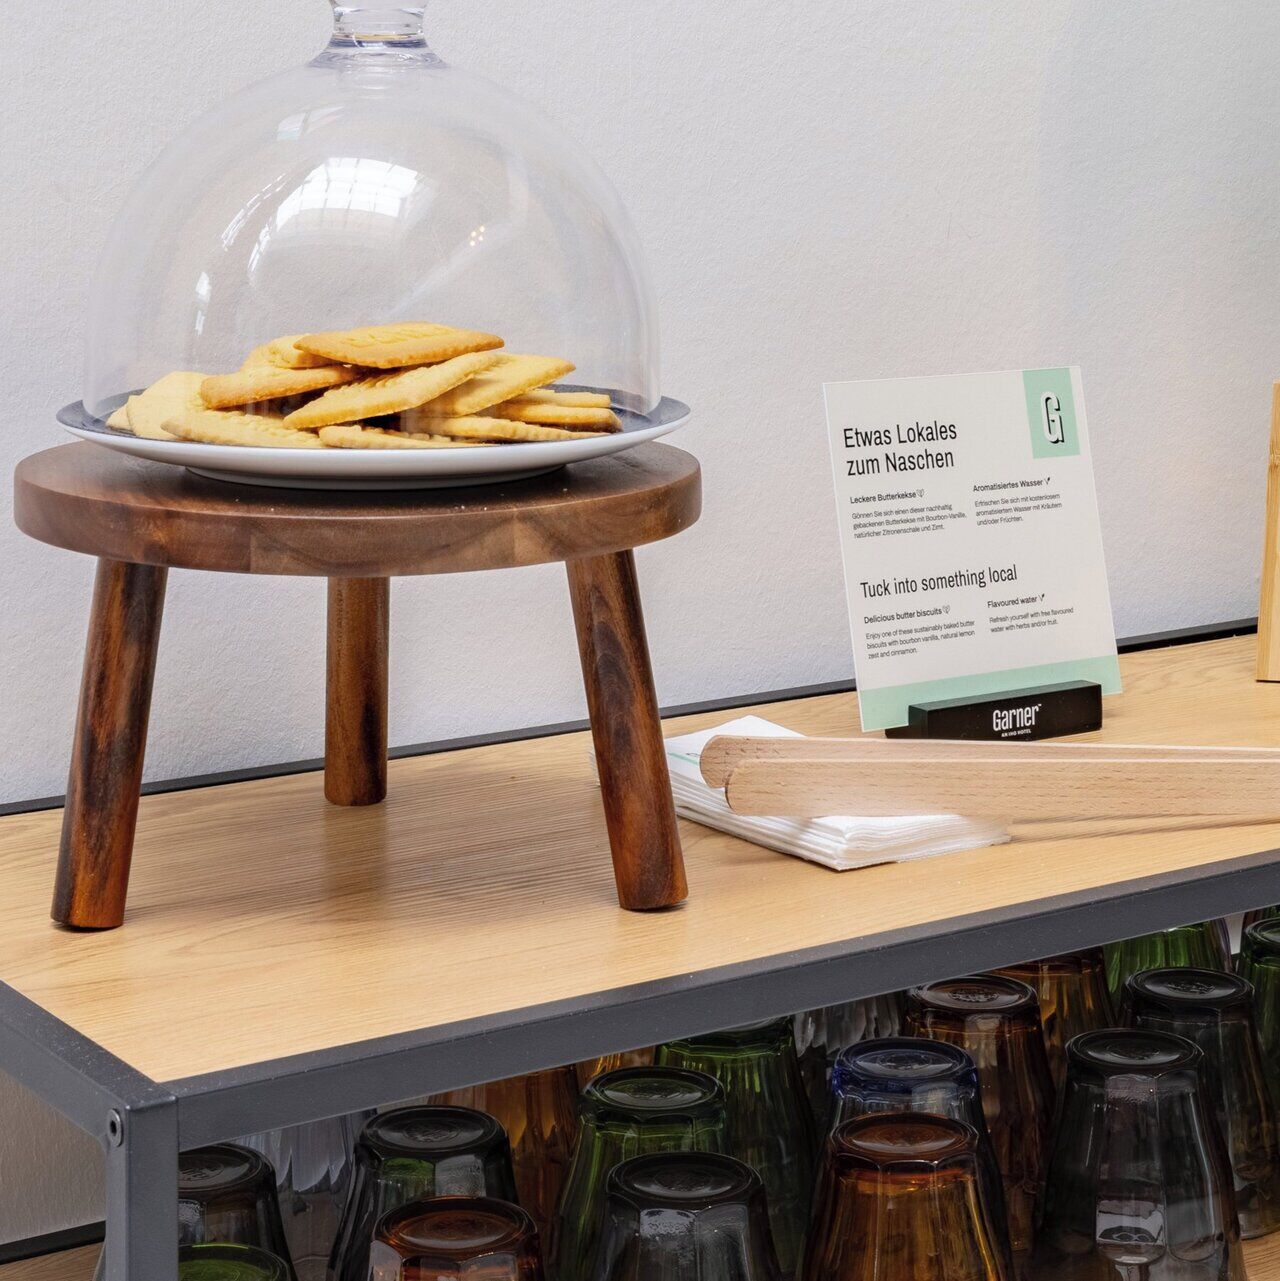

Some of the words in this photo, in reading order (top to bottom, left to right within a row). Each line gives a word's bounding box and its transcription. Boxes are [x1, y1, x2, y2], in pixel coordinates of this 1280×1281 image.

[1040, 391, 1064, 444] G
[844, 428, 892, 448] Etwas
[896, 420, 957, 443] Lokales
[846, 457, 880, 476] zum
[885, 448, 954, 472] Naschen
[850, 494, 876, 504] Leckere
[878, 490, 916, 501] Butterkekse
[973, 481, 1019, 492] Aromatisiertes
[1020, 479, 1043, 487] Wasser
[860, 579, 891, 598] Tuck
[894, 578, 917, 594] into
[921, 569, 986, 591] something
[989, 564, 1017, 583] local
[987, 598, 1019, 608] Flavoured
[1020, 595, 1038, 604] water
[864, 613, 895, 624] Delicious
[896, 611, 915, 620] butter
[916, 608, 942, 617] biscuits
[993, 705, 1039, 731] Garner
